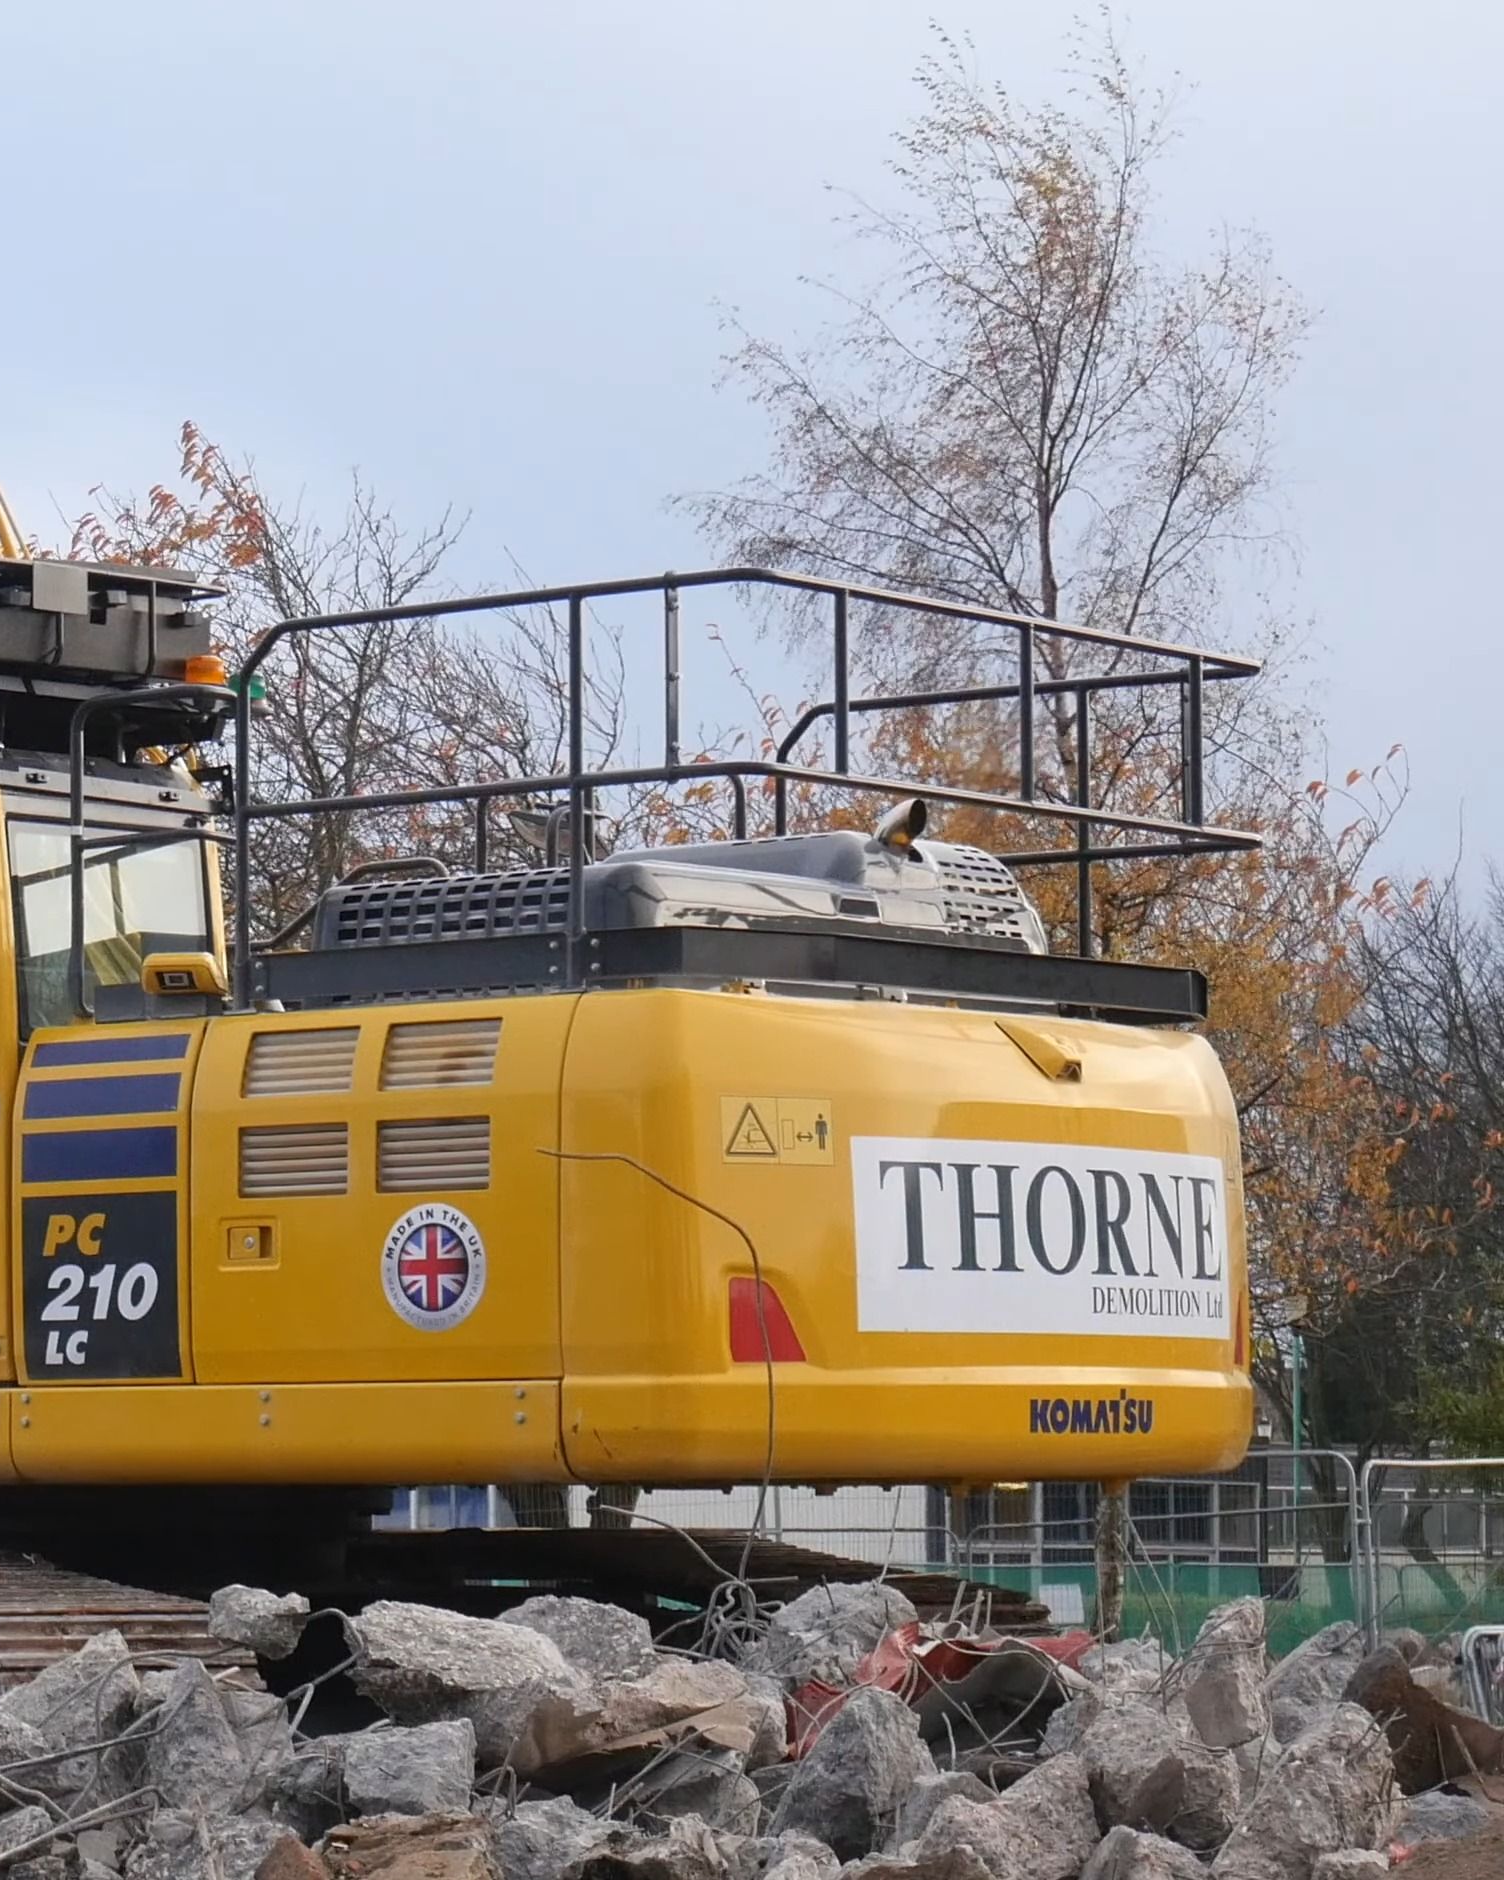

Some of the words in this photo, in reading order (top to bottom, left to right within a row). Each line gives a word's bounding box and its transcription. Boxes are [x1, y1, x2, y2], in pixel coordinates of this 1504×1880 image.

[42, 1213, 106, 1257] PC
[385, 1217, 415, 1260] MADE
[419, 1208, 434, 1221] IN
[442, 1209, 468, 1233] THE
[468, 1235, 482, 1259] UK
[879, 1160, 1222, 1282] THORNE
[41, 1261, 158, 1322] 210
[1092, 1286, 1201, 1318] DEMOLITION
[1206, 1290, 1223, 1320] Ltd
[45, 1330, 88, 1366] LC
[1029, 1388, 1154, 1434] KOMATSU
